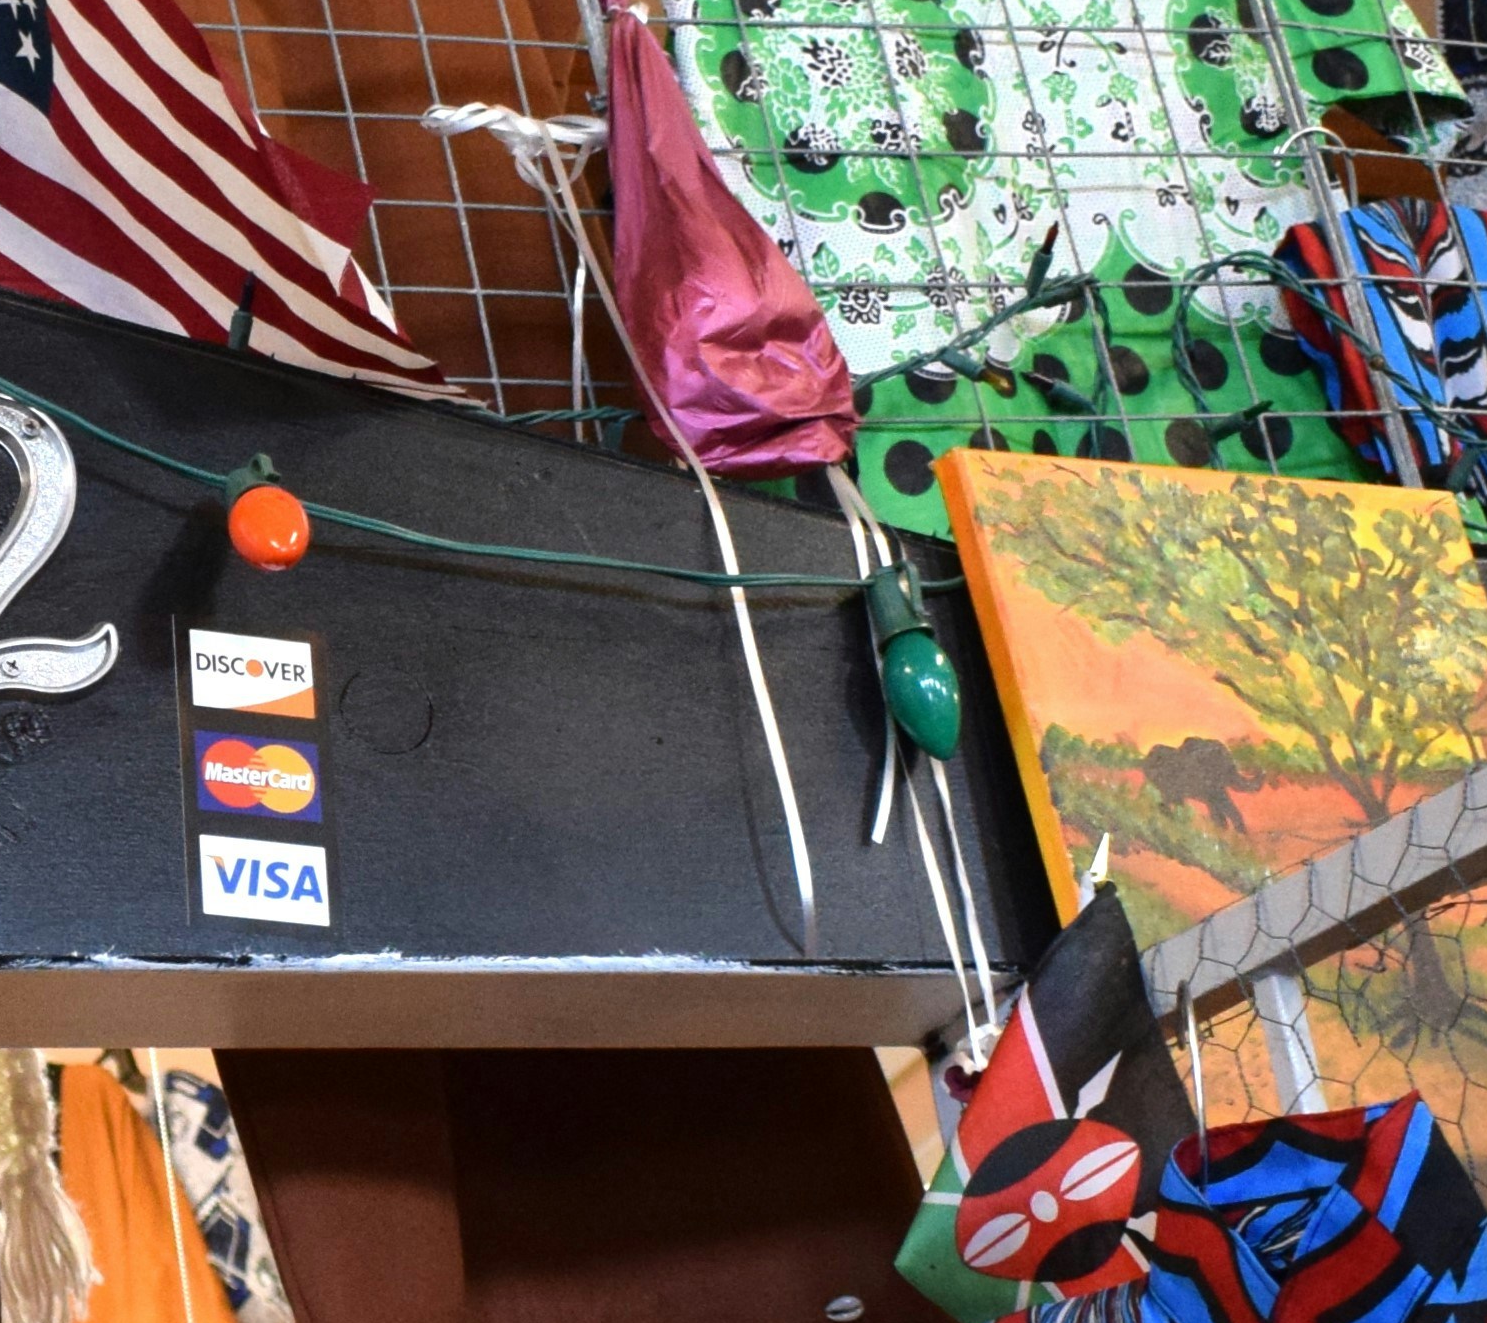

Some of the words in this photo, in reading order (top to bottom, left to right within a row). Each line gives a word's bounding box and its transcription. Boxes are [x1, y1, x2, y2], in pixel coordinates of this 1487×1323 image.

[195, 651, 307, 685] DISCOVER
[204, 761, 312, 793] MasterCard
[207, 854, 323, 903] VISA
